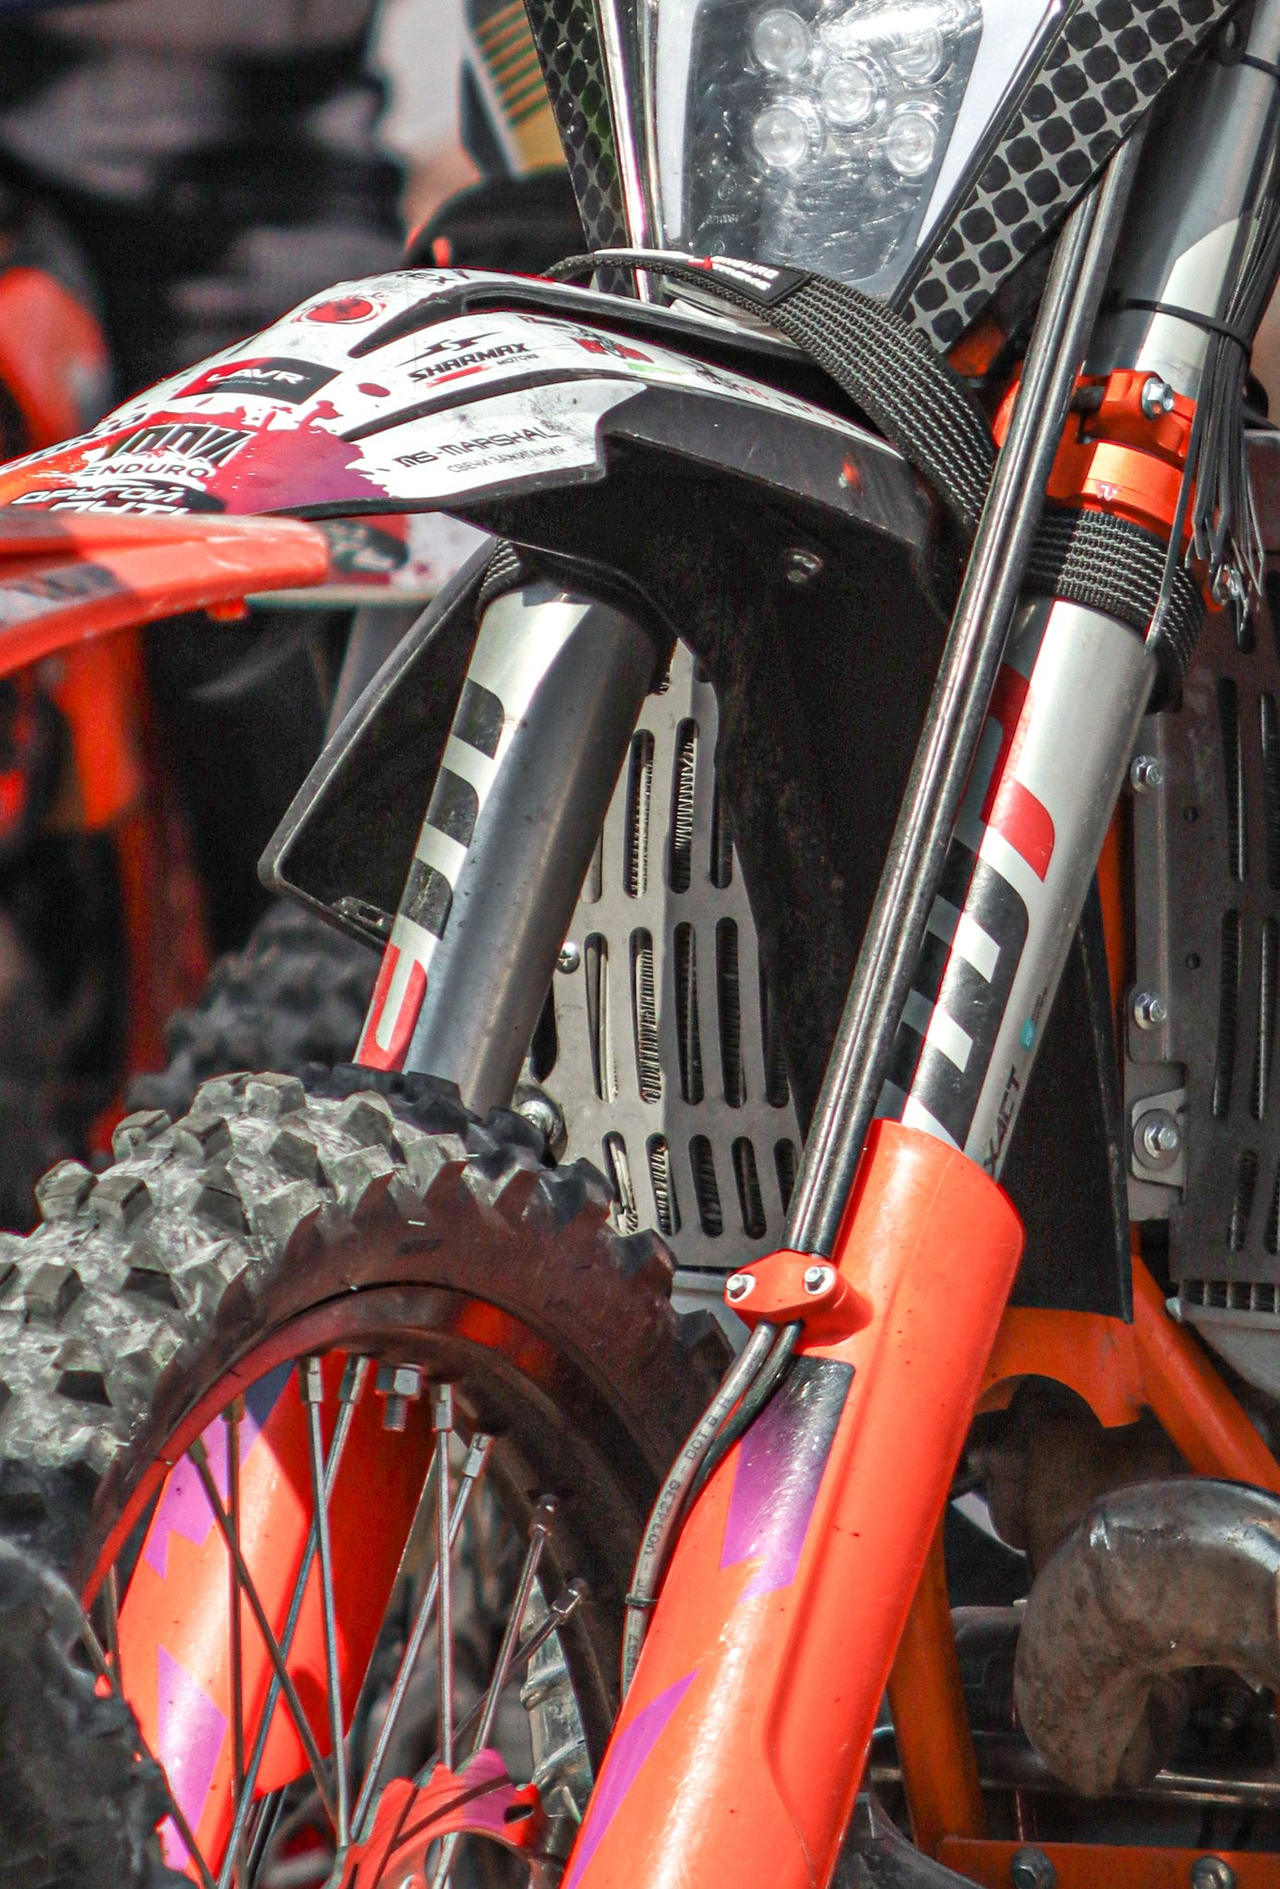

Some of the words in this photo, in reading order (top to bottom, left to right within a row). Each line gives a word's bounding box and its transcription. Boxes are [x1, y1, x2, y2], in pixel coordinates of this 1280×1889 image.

[408, 342, 531, 383] SHARMAX
[206, 367, 308, 385] LAVR
[81, 462, 210, 479] ENDURO
